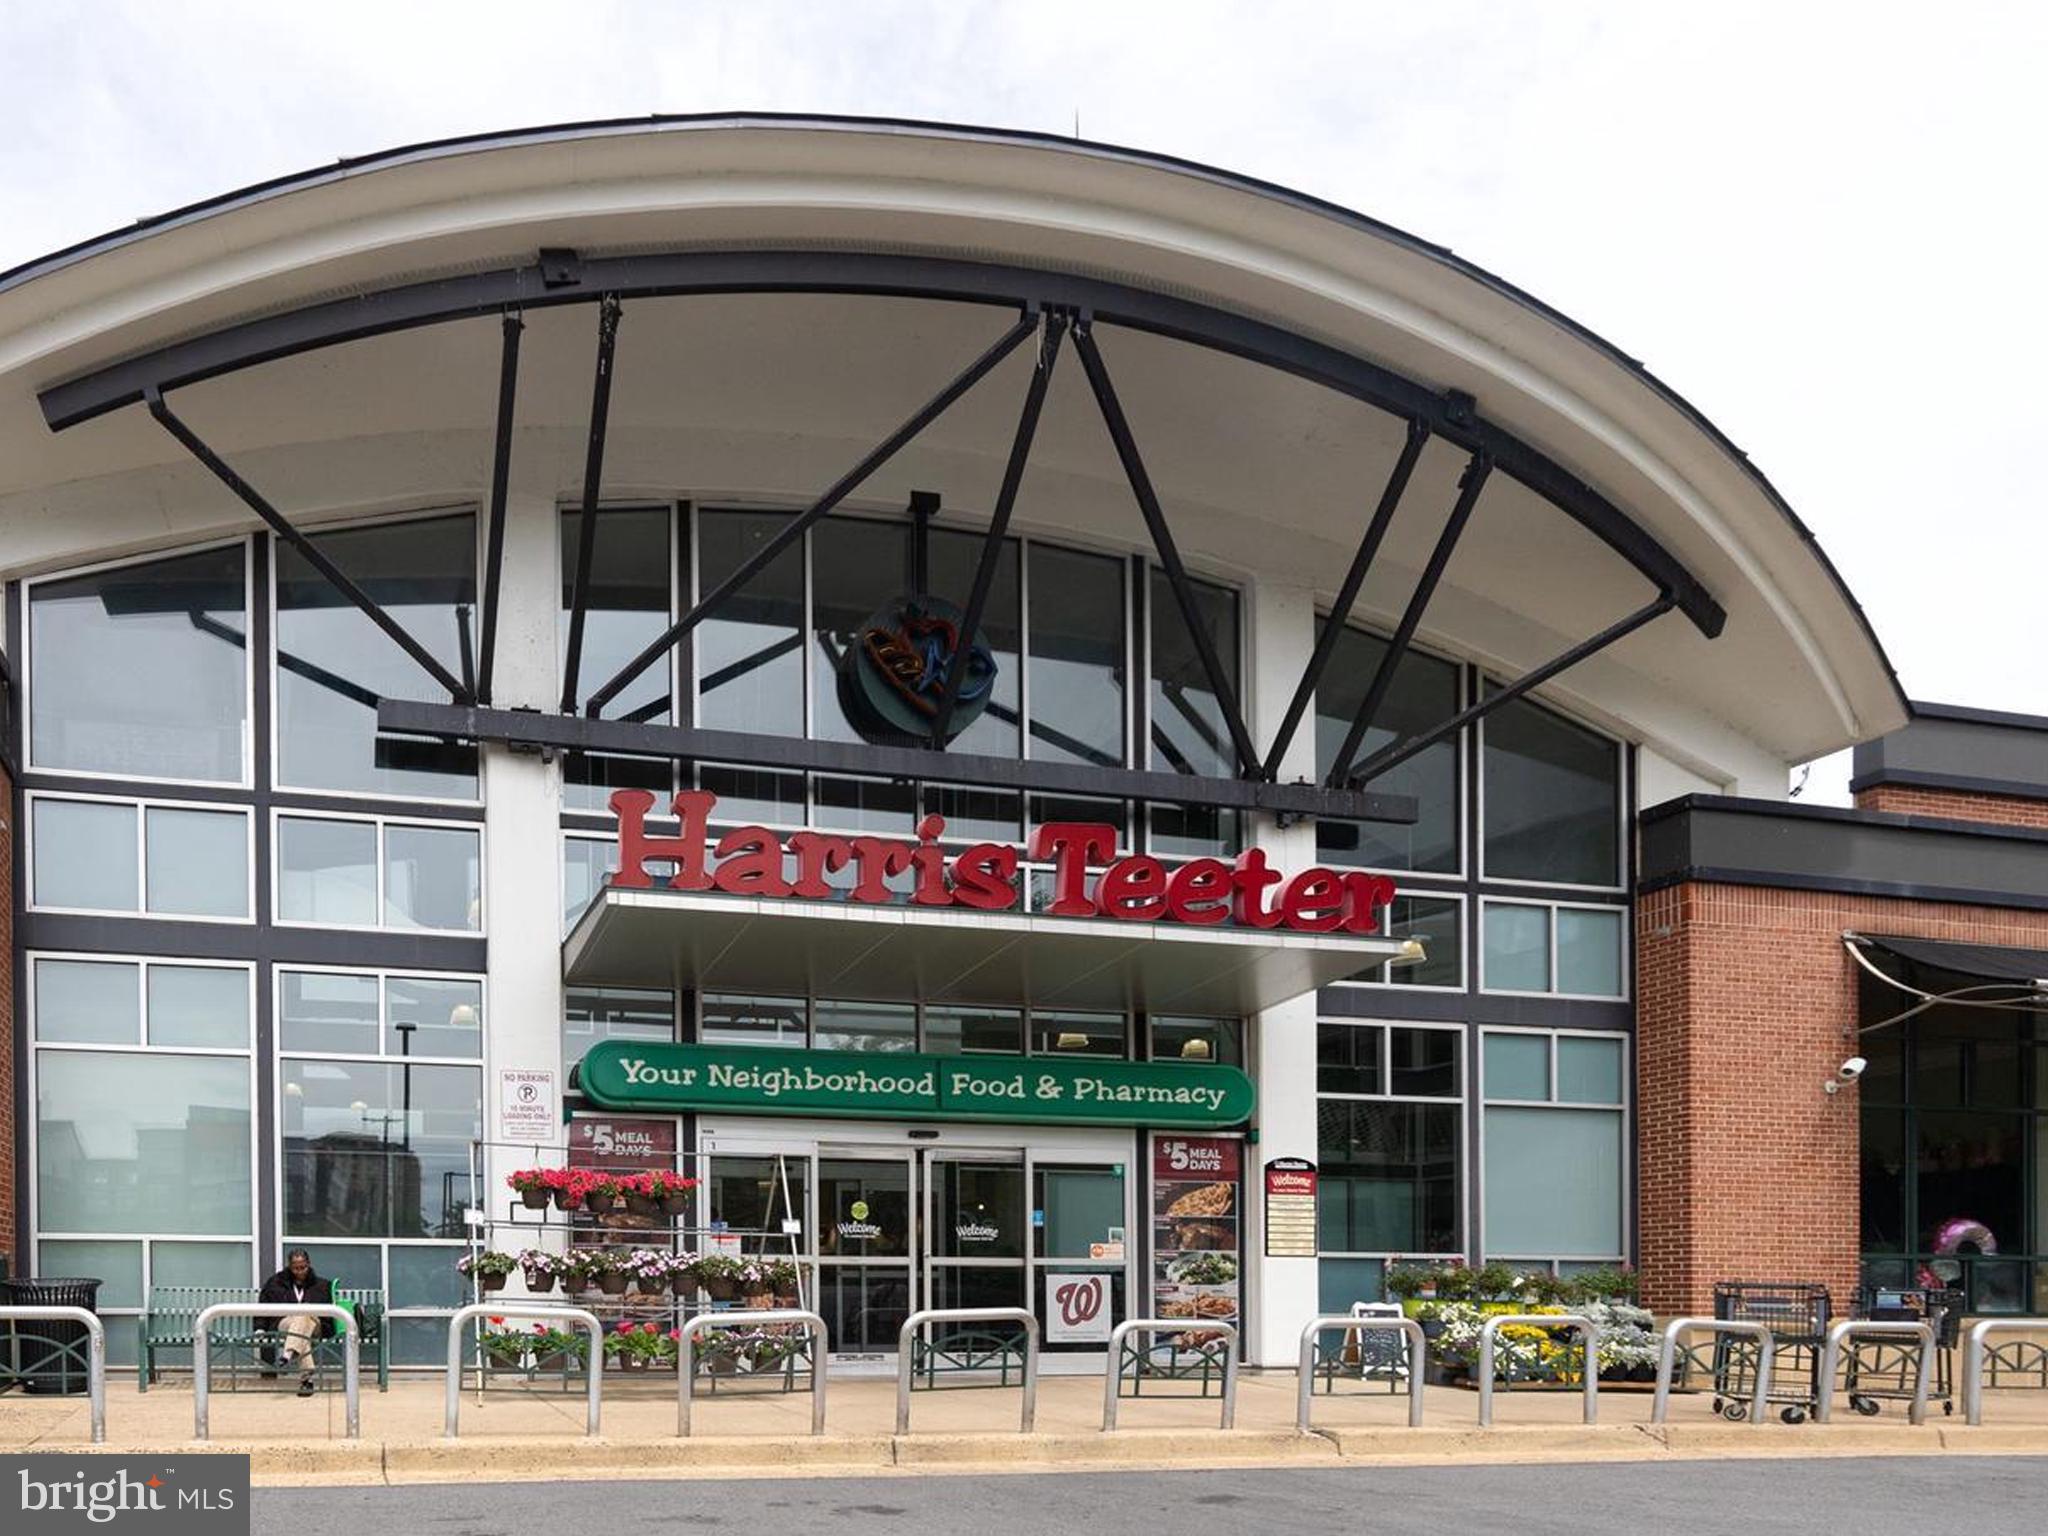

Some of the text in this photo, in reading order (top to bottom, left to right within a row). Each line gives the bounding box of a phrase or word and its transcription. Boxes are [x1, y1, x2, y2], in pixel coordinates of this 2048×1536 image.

[608, 789, 1396, 933] Harris Teeter
[504, 1073, 550, 1083] NO PARKING
[619, 1058, 1226, 1111] Your Neighborhood Food & Pharmacy
[583, 1124, 654, 1156] $5 MEAL
[614, 1144, 654, 1157] DAYS
[1162, 1141, 1222, 1170] $5 MEAL
[1189, 1160, 1222, 1171] DAYS
[1271, 1173, 1312, 1188] Welcome
[837, 1221, 881, 1235] Welcome
[956, 1223, 999, 1238] Welcome
[1056, 1277, 1102, 1326] W
